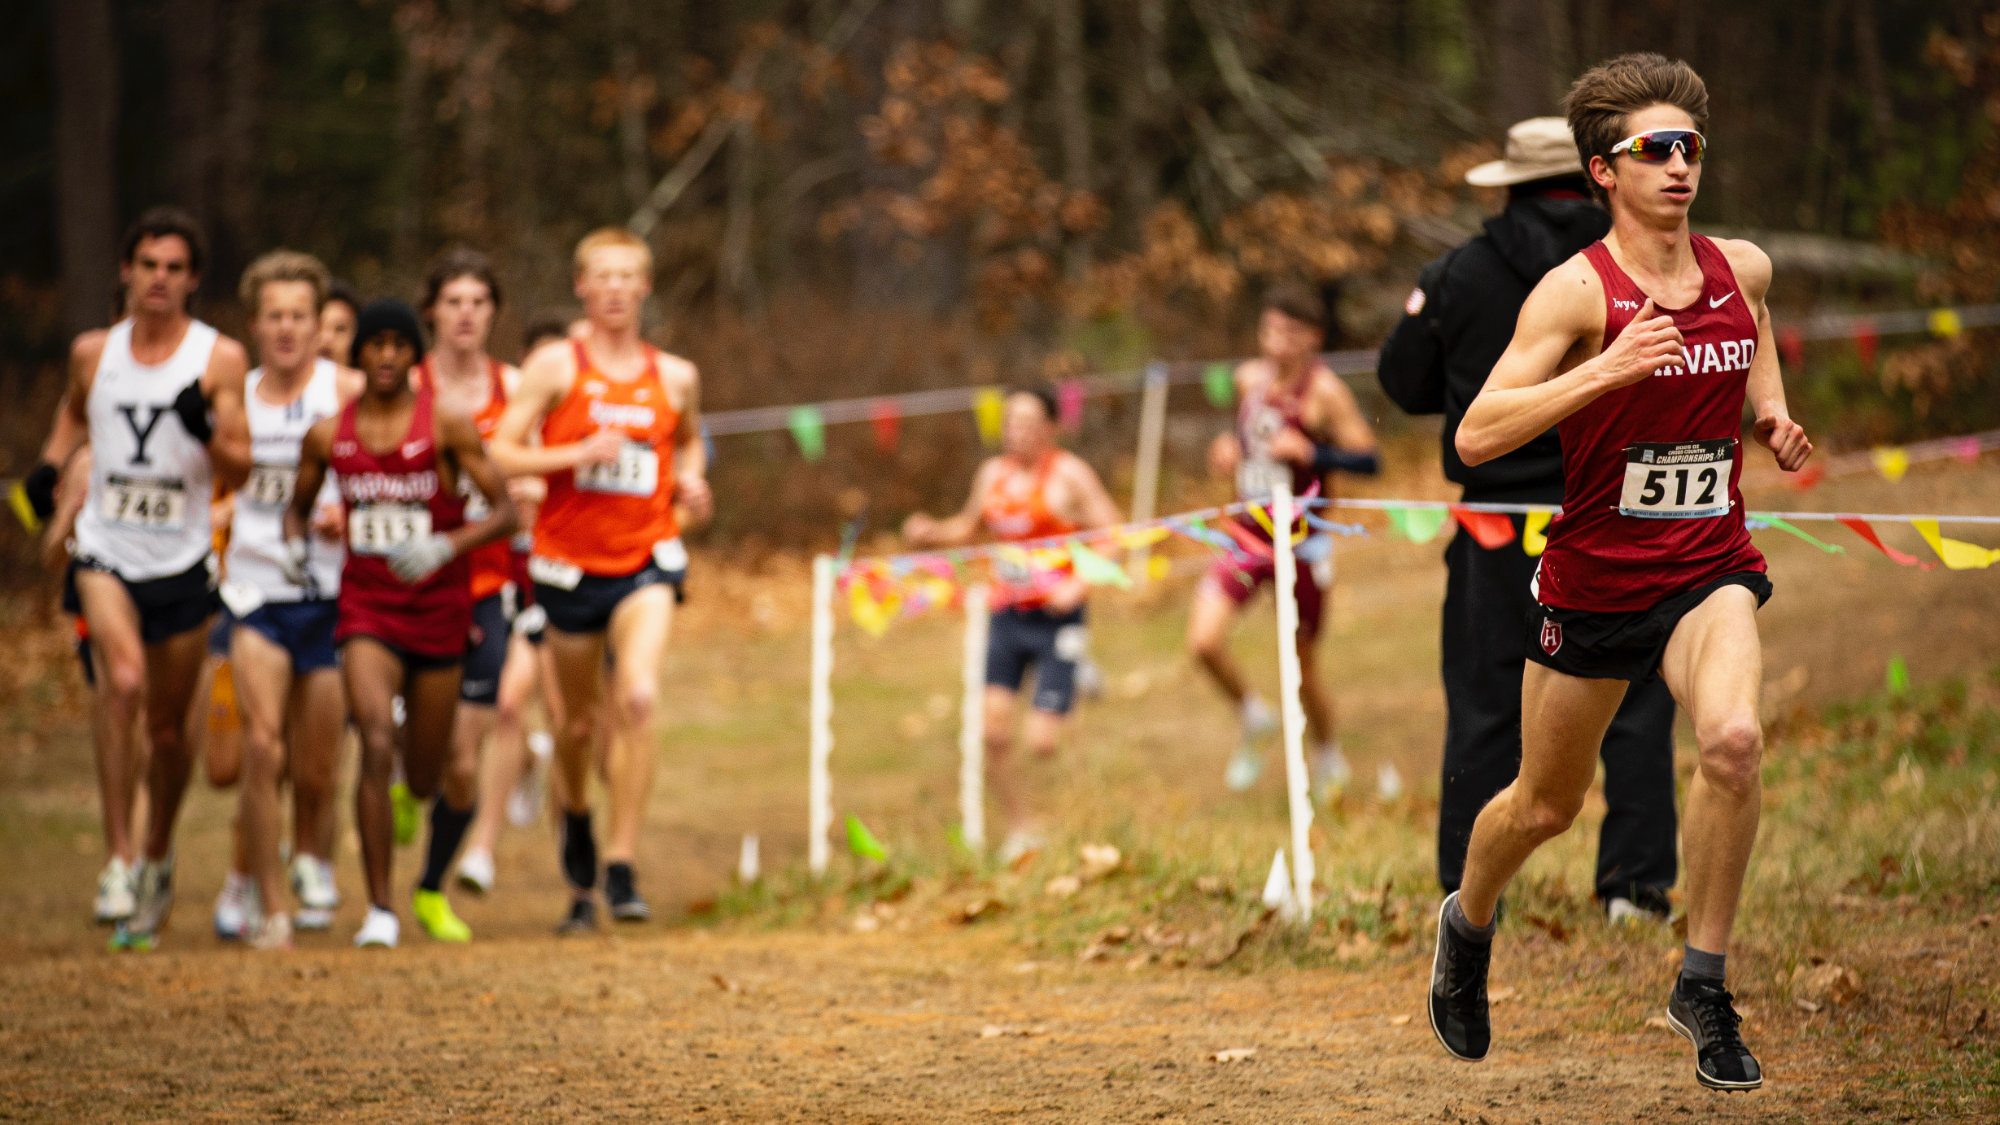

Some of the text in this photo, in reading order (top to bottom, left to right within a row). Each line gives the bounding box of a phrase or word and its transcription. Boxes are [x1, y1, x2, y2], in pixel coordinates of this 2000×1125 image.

[1654, 339, 1755, 376] VARD
[115, 403, 172, 465] Y
[1656, 453, 1715, 464] CHAMPIONSHIPS
[1639, 467, 1718, 506] 512
[1543, 627, 1557, 647] H
